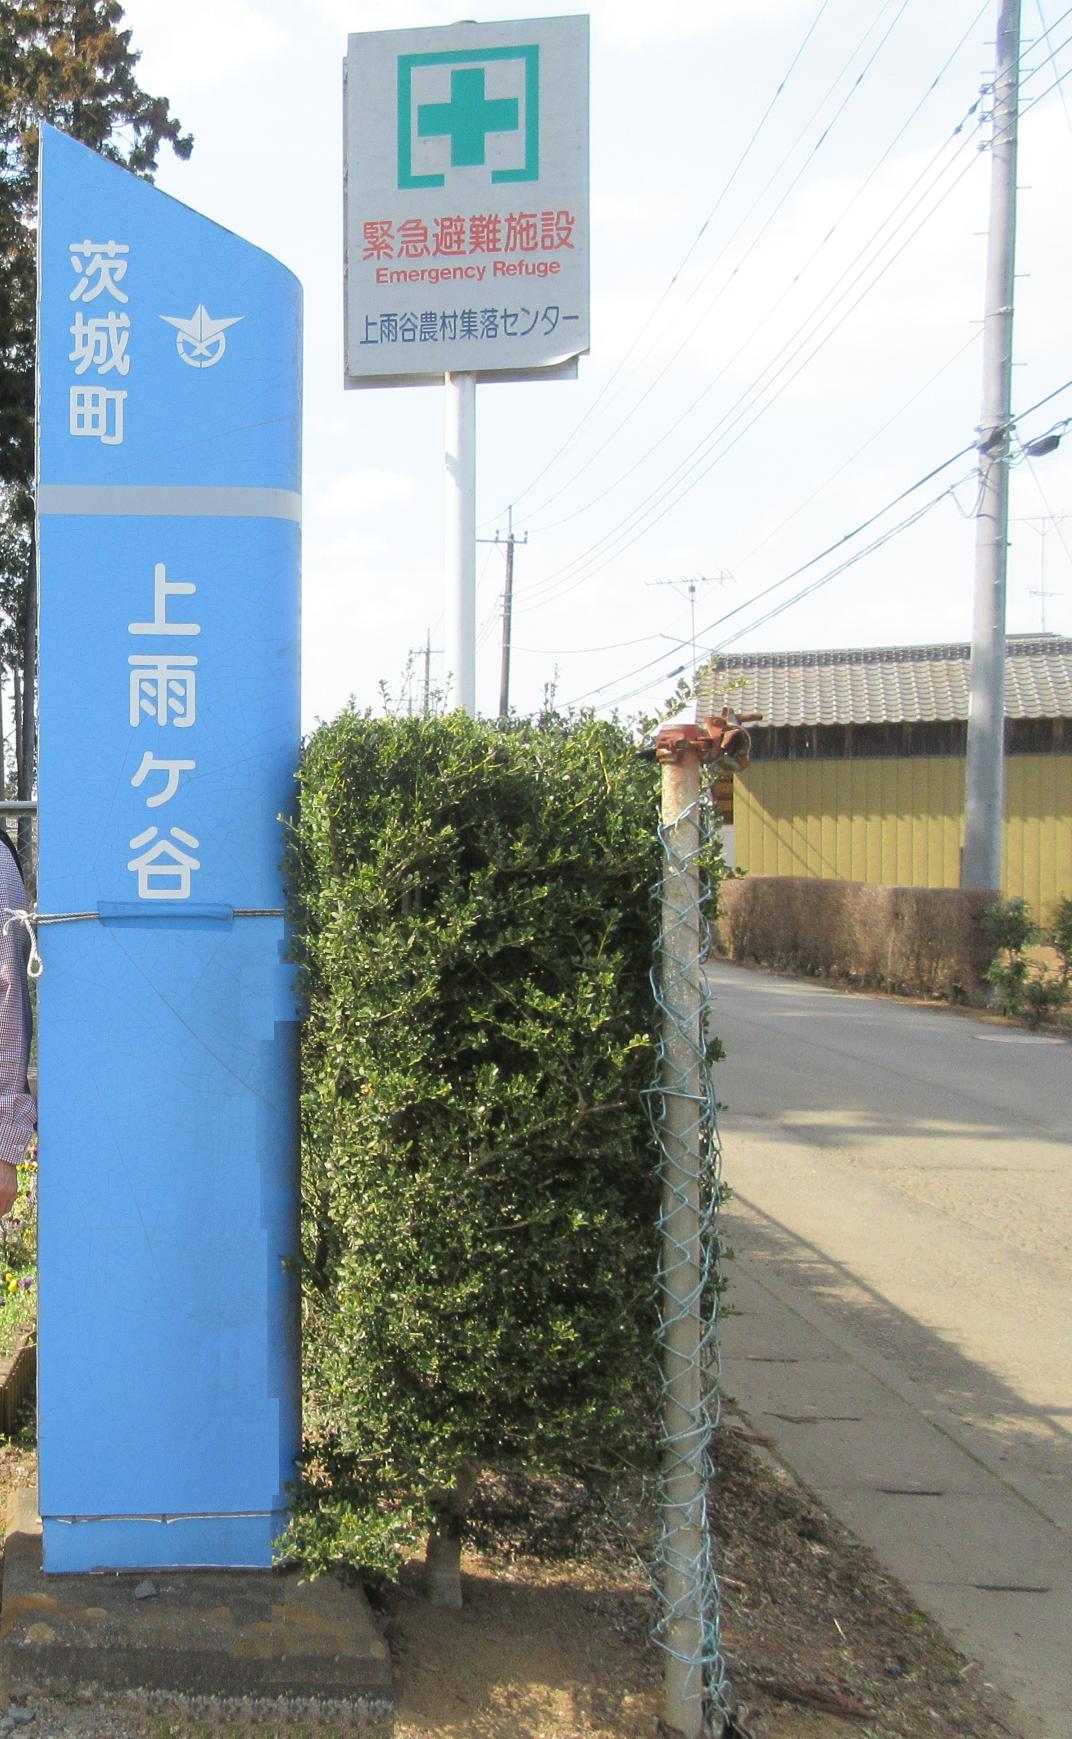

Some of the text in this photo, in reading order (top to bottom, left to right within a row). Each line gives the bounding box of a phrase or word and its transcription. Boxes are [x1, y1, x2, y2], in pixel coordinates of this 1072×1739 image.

[363, 210, 576, 261] 緊急避難施設
[375, 259, 561, 285] Emergency Refuge
[69, 239, 131, 446] 茨城町
[359, 306, 580, 345] 上雨谷農村集落センター
